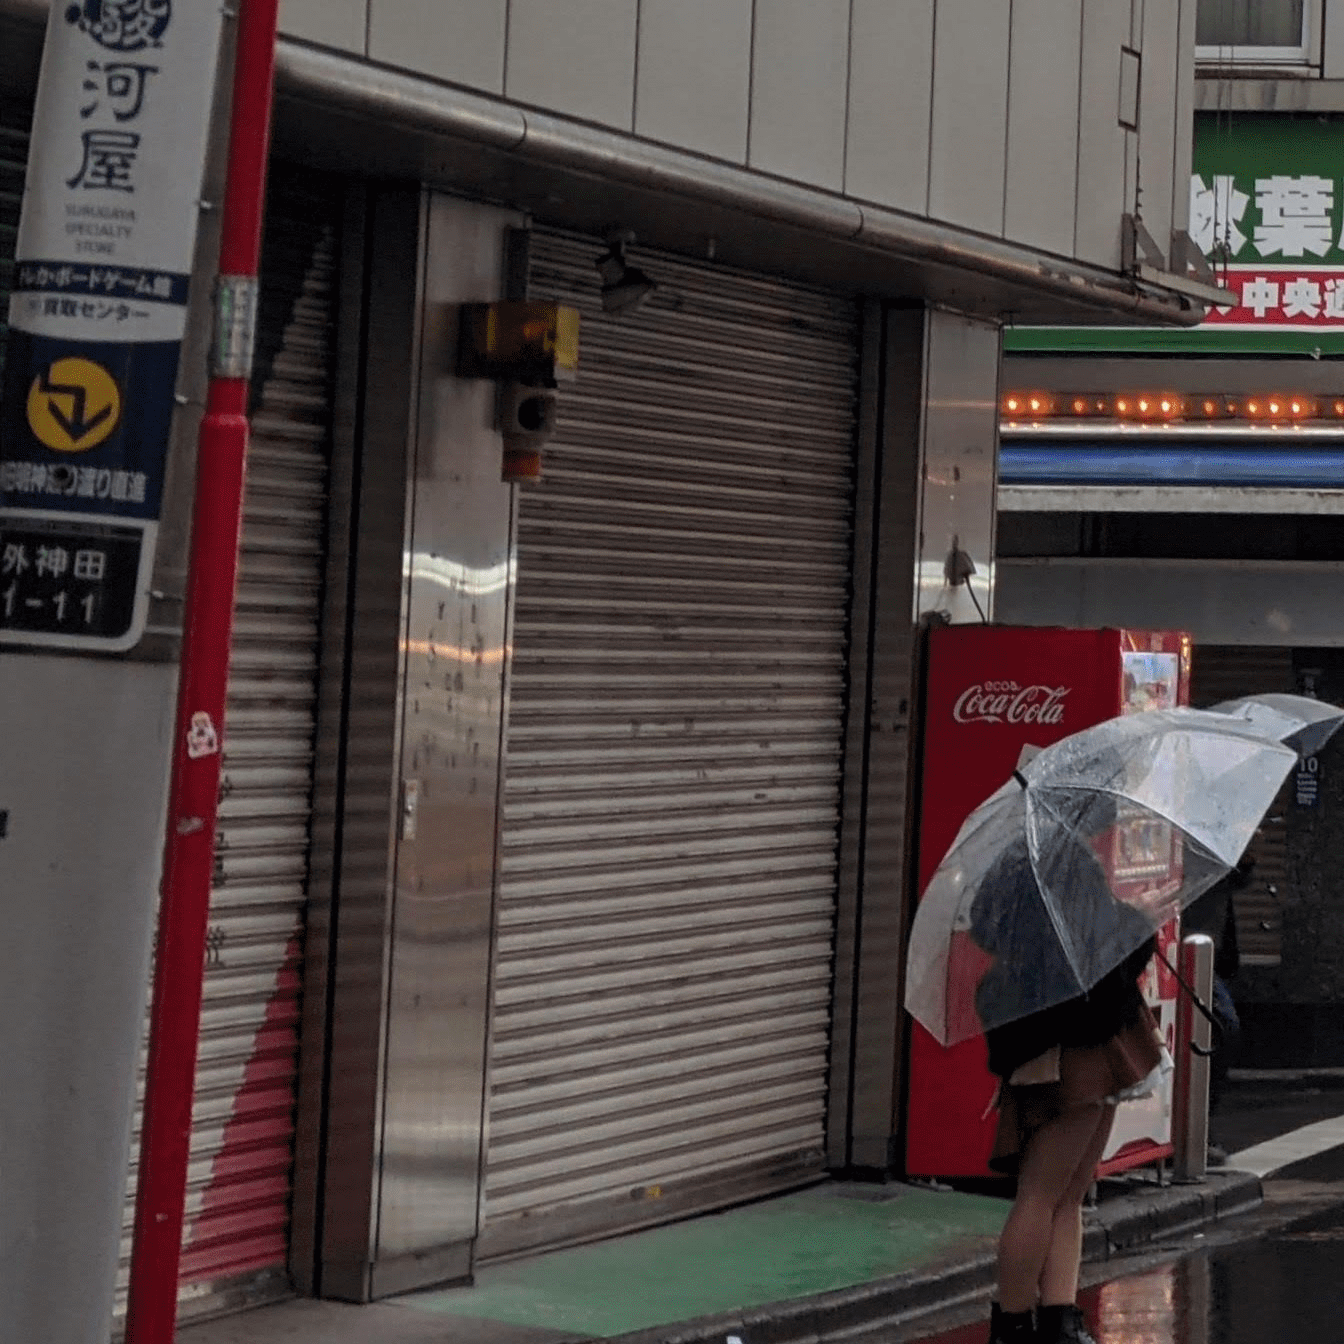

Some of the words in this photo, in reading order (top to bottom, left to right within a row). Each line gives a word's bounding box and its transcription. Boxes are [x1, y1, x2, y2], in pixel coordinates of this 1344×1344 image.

[2, 542, 107, 580] 外神田
[3, 579, 95, 625] 1-11
[953, 684, 1073, 725] Coca-Cola
